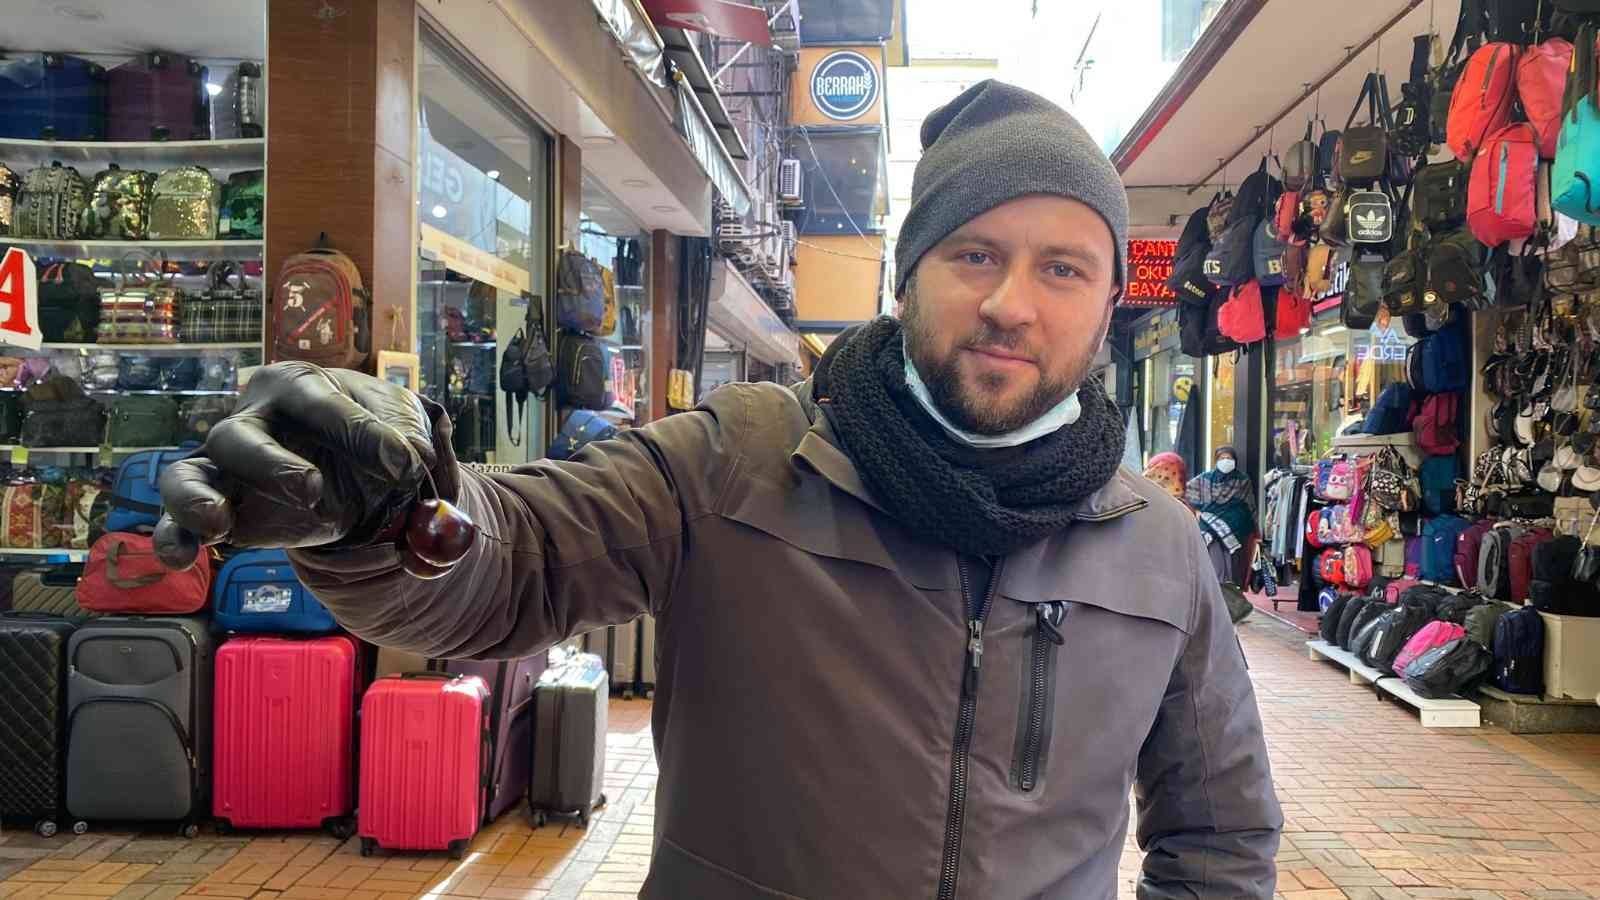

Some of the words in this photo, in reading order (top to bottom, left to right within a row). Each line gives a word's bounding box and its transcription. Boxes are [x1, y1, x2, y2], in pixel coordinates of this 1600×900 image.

[1132, 242, 1178, 259] ÇANT
[0, 250, 33, 336] A
[287, 285, 304, 308] 5
[1129, 282, 1177, 298] BAYA
